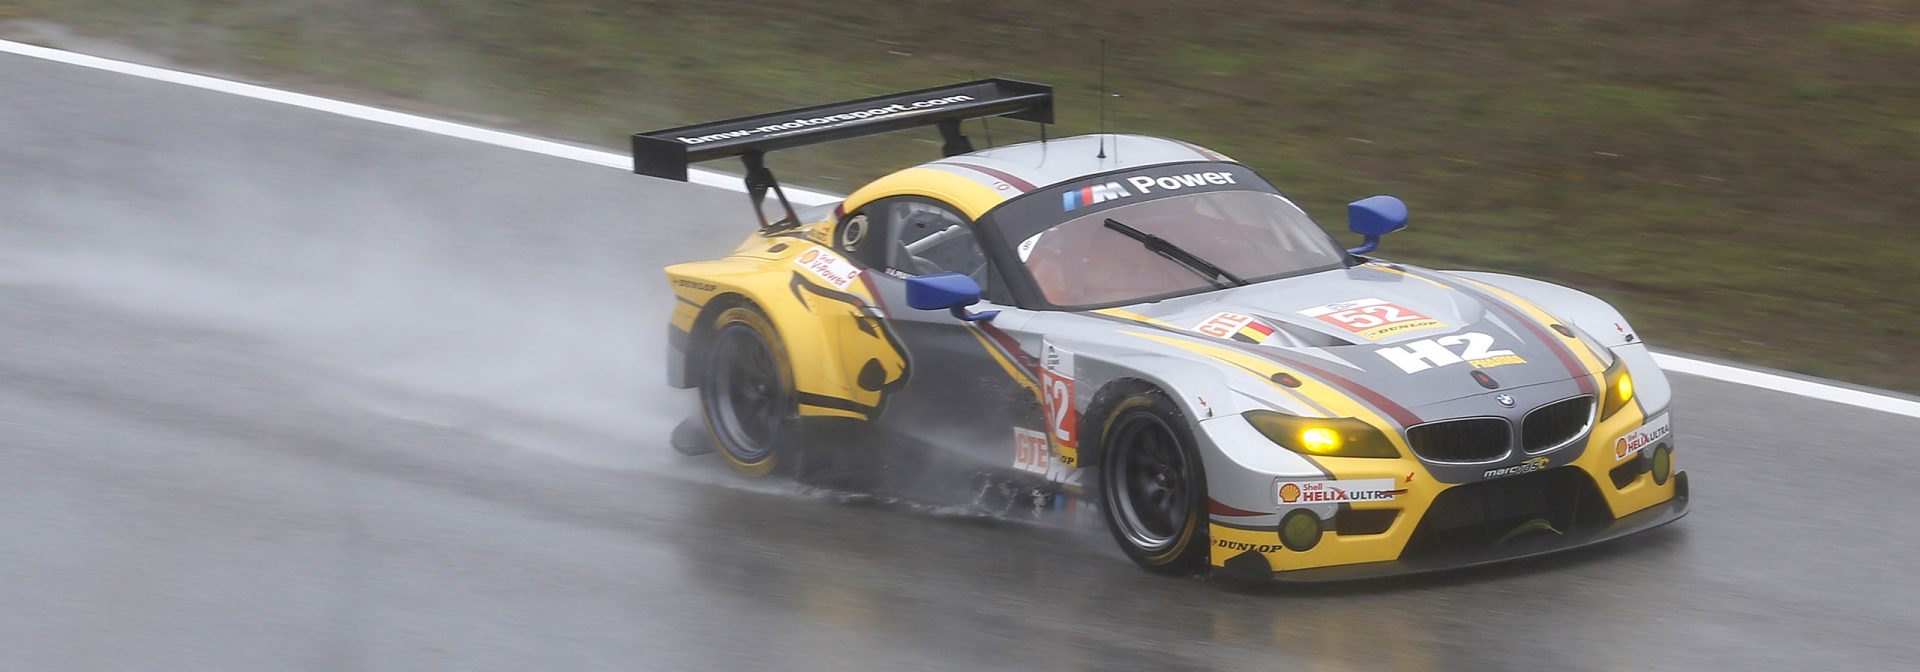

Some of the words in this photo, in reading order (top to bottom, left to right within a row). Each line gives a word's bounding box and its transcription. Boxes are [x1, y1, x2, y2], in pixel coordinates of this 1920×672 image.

[677, 95, 974, 145] bmw-motorsport.com
[1127, 169, 1237, 194] Power
[810, 260, 848, 286] V-Power
[1200, 312, 1249, 338] GTE
[1332, 304, 1423, 329] 52
[1378, 321, 1438, 334] DUNLOP
[1375, 332, 1516, 374] H2
[1043, 373, 1071, 442] 52
[1015, 432, 1048, 468] GTE
[1628, 433, 1649, 452] HELIX
[1303, 483, 1323, 491] Shell
[1303, 488, 1349, 502] HELIX
[1218, 539, 1282, 553] DUNLOP
